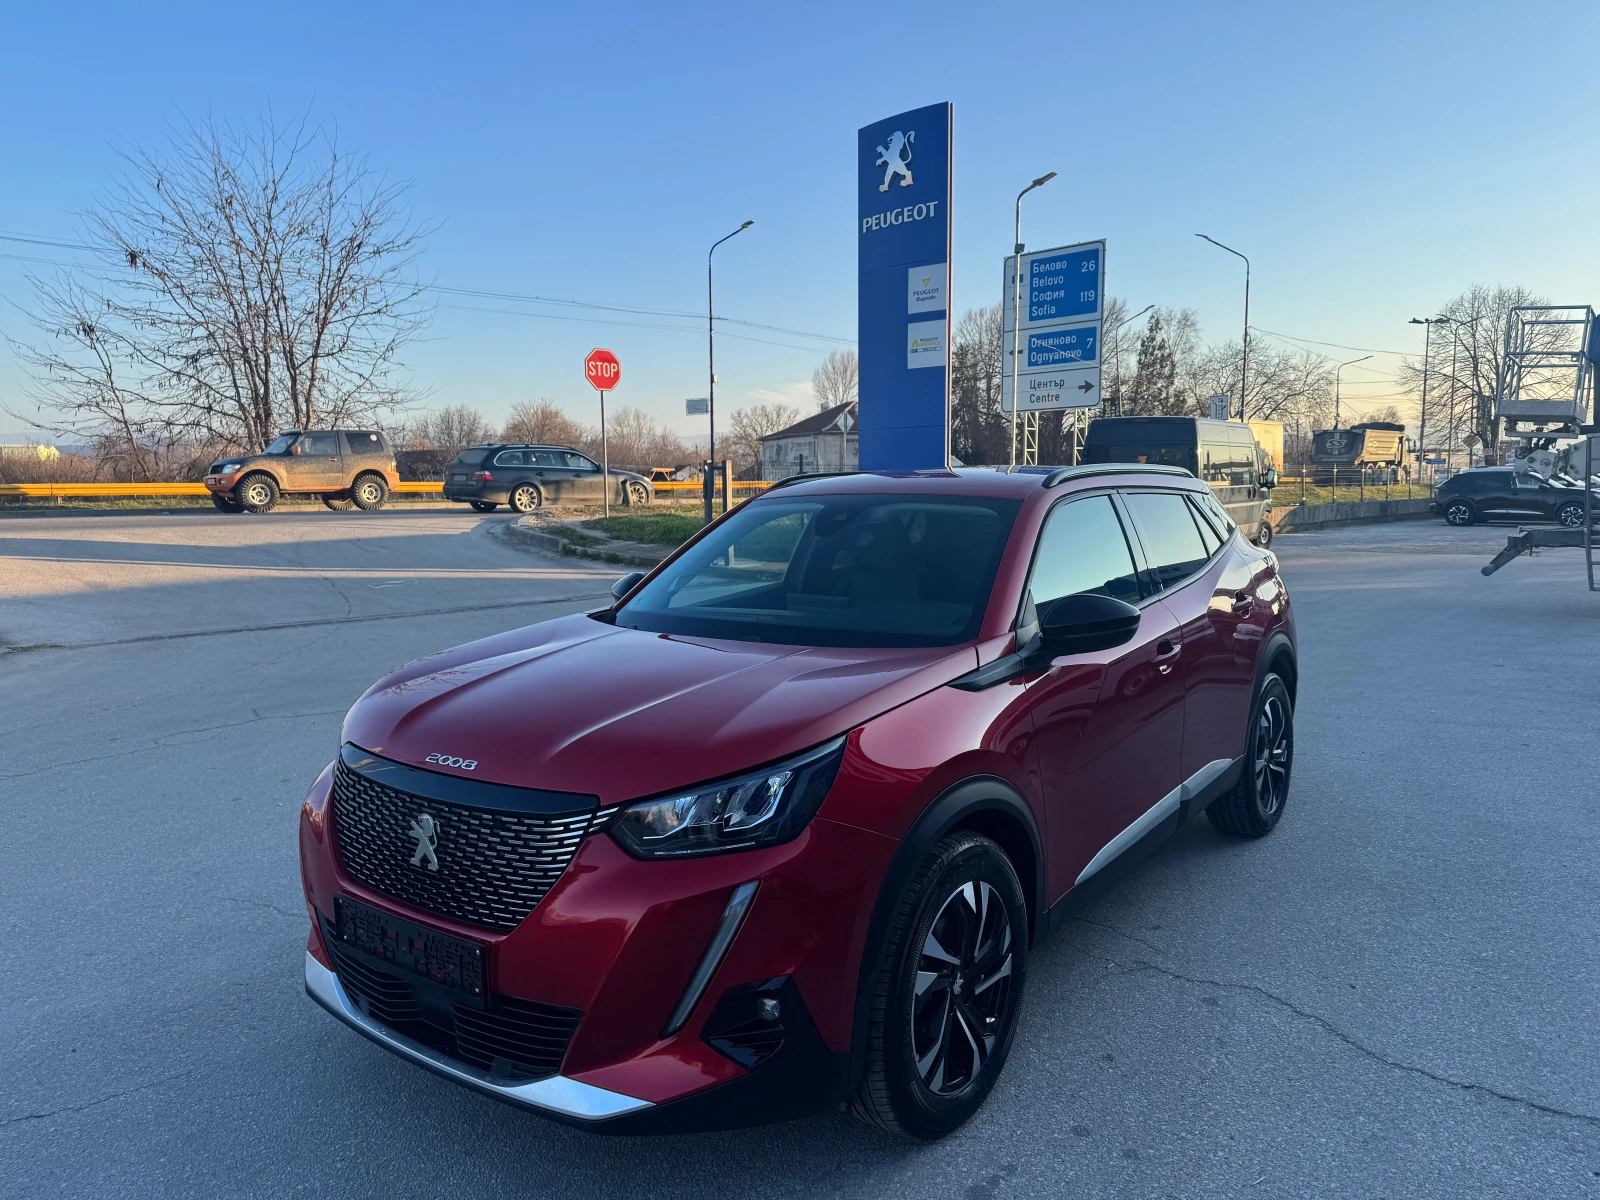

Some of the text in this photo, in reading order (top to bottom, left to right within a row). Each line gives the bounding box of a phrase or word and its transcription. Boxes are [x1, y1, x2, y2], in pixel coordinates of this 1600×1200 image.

[862, 201, 939, 234] PEUGEOT
[1032, 260, 1096, 274] Белово 26
[1032, 275, 1064, 288] Belovo
[912, 287, 940, 297] PEUGEOT
[1032, 290, 1095, 302] София 119
[1031, 304, 1056, 316] Sofia
[1031, 335, 1094, 349] Огняново 7
[1030, 349, 1082, 363] Ognyanovo
[588, 360, 619, 378] STOP
[1029, 379, 1065, 391] Център
[1029, 393, 1060, 404] Centre
[424, 752, 479, 770] 2008
